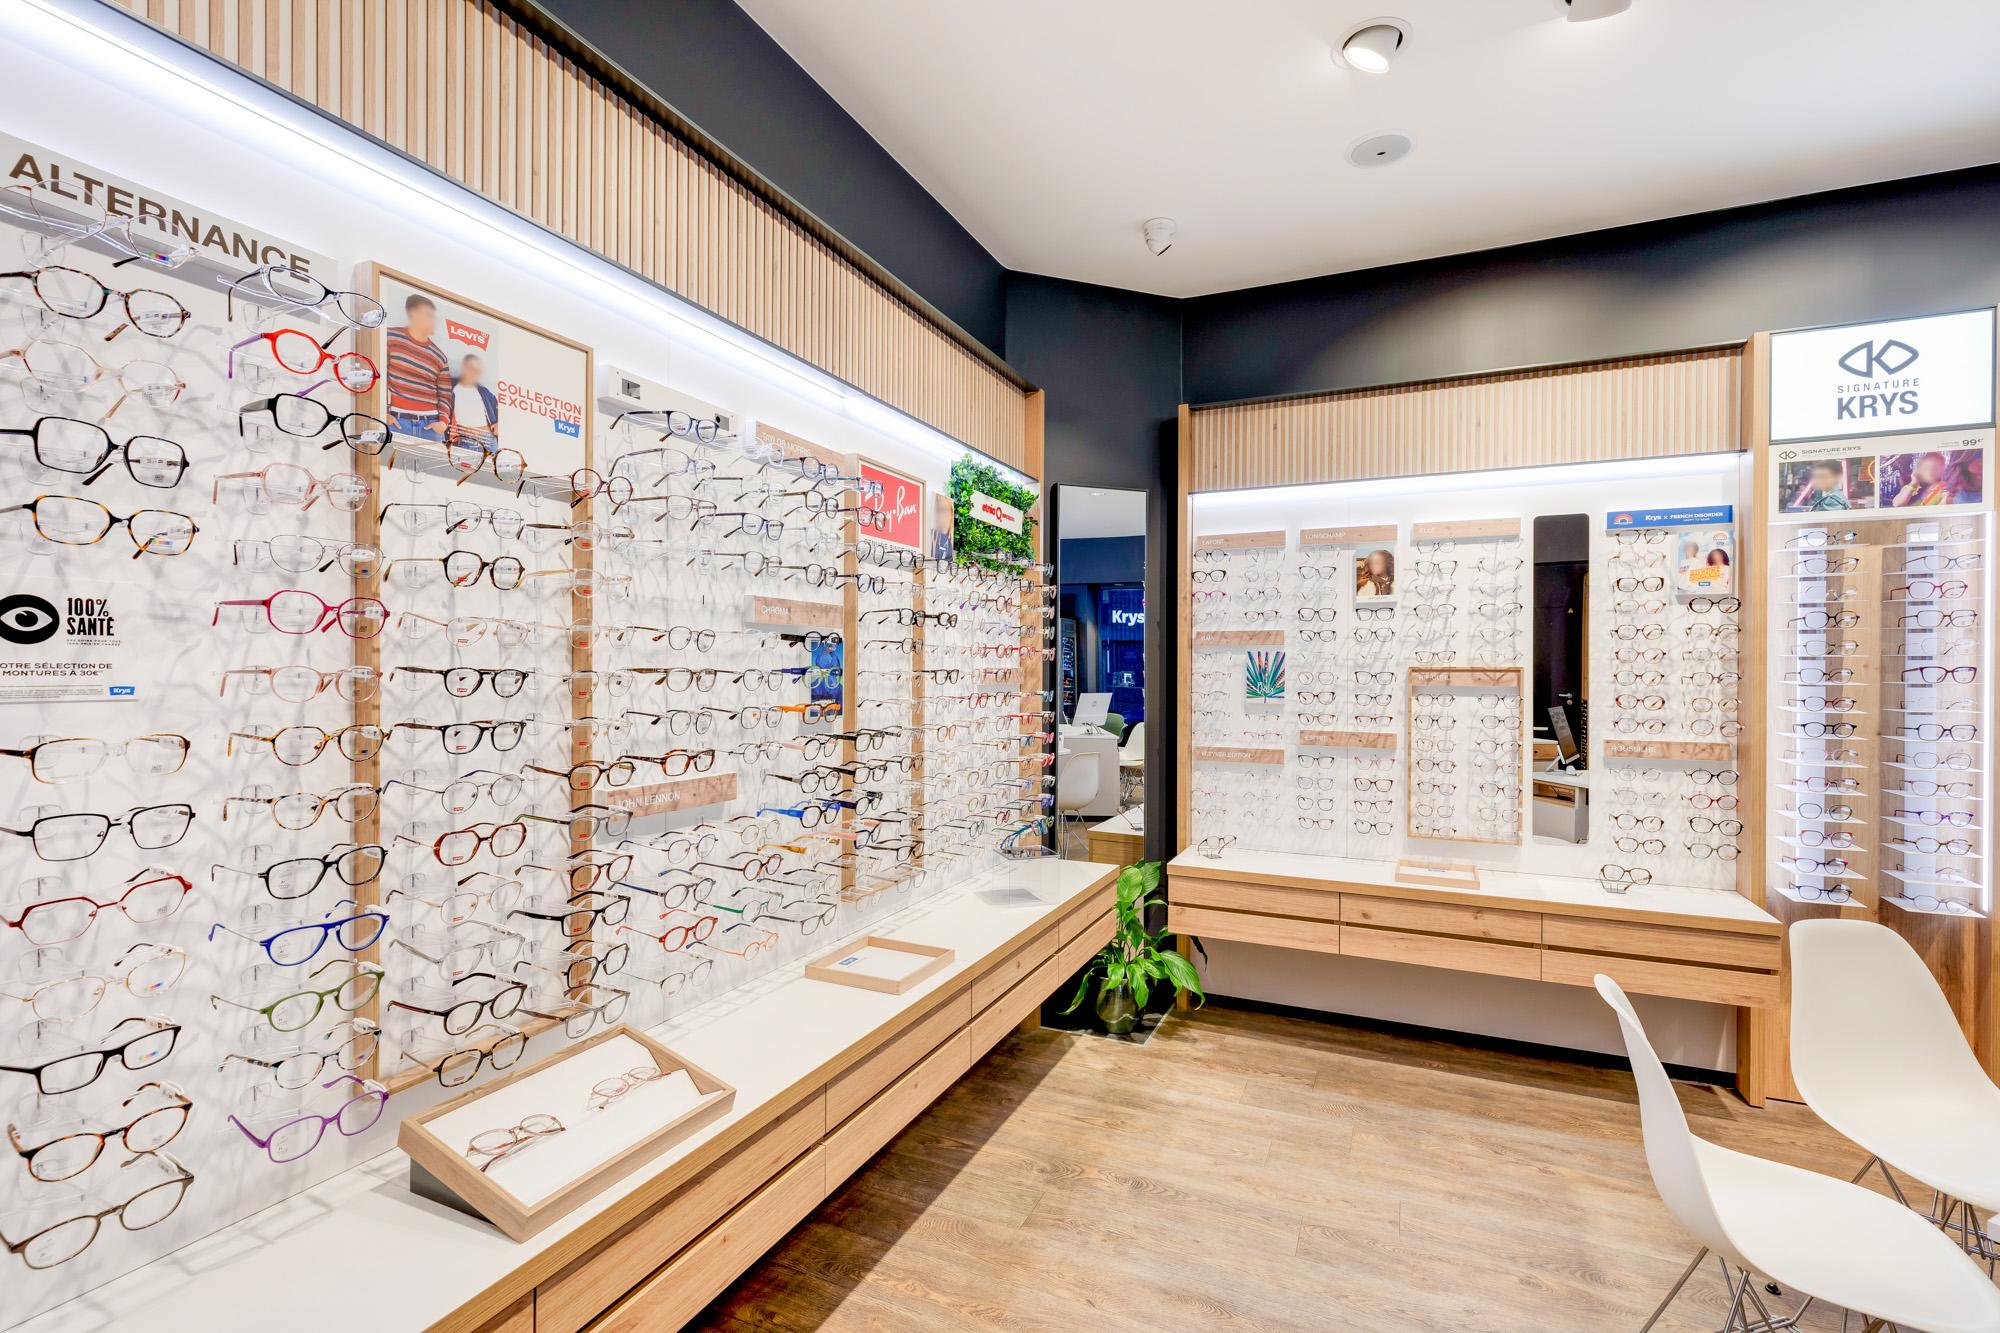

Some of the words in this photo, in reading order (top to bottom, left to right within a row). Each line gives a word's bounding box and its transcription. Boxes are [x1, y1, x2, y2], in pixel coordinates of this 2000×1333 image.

[9, 153, 311, 283] ALTERNANCE
[1837, 378, 1919, 393] SIGNATURE
[497, 380, 582, 416] COLLECTION
[1837, 390, 1919, 420] KRYS
[497, 393, 582, 428] EXCLUSIVE
[558, 422, 576, 434] Krys
[1801, 447, 1841, 455] SIGNATURE
[1645, 514, 1662, 522] Krys
[67, 597, 109, 617] 100%
[761, 605, 789, 616] CHROMA
[67, 616, 114, 636] SANTÉ
[1112, 610, 1145, 626] Krys
[34, 661, 96, 669] SÉLECTION
[113, 687, 131, 695] Krys
[618, 797, 642, 809] JOHN
[644, 791, 680, 806] LENNON
